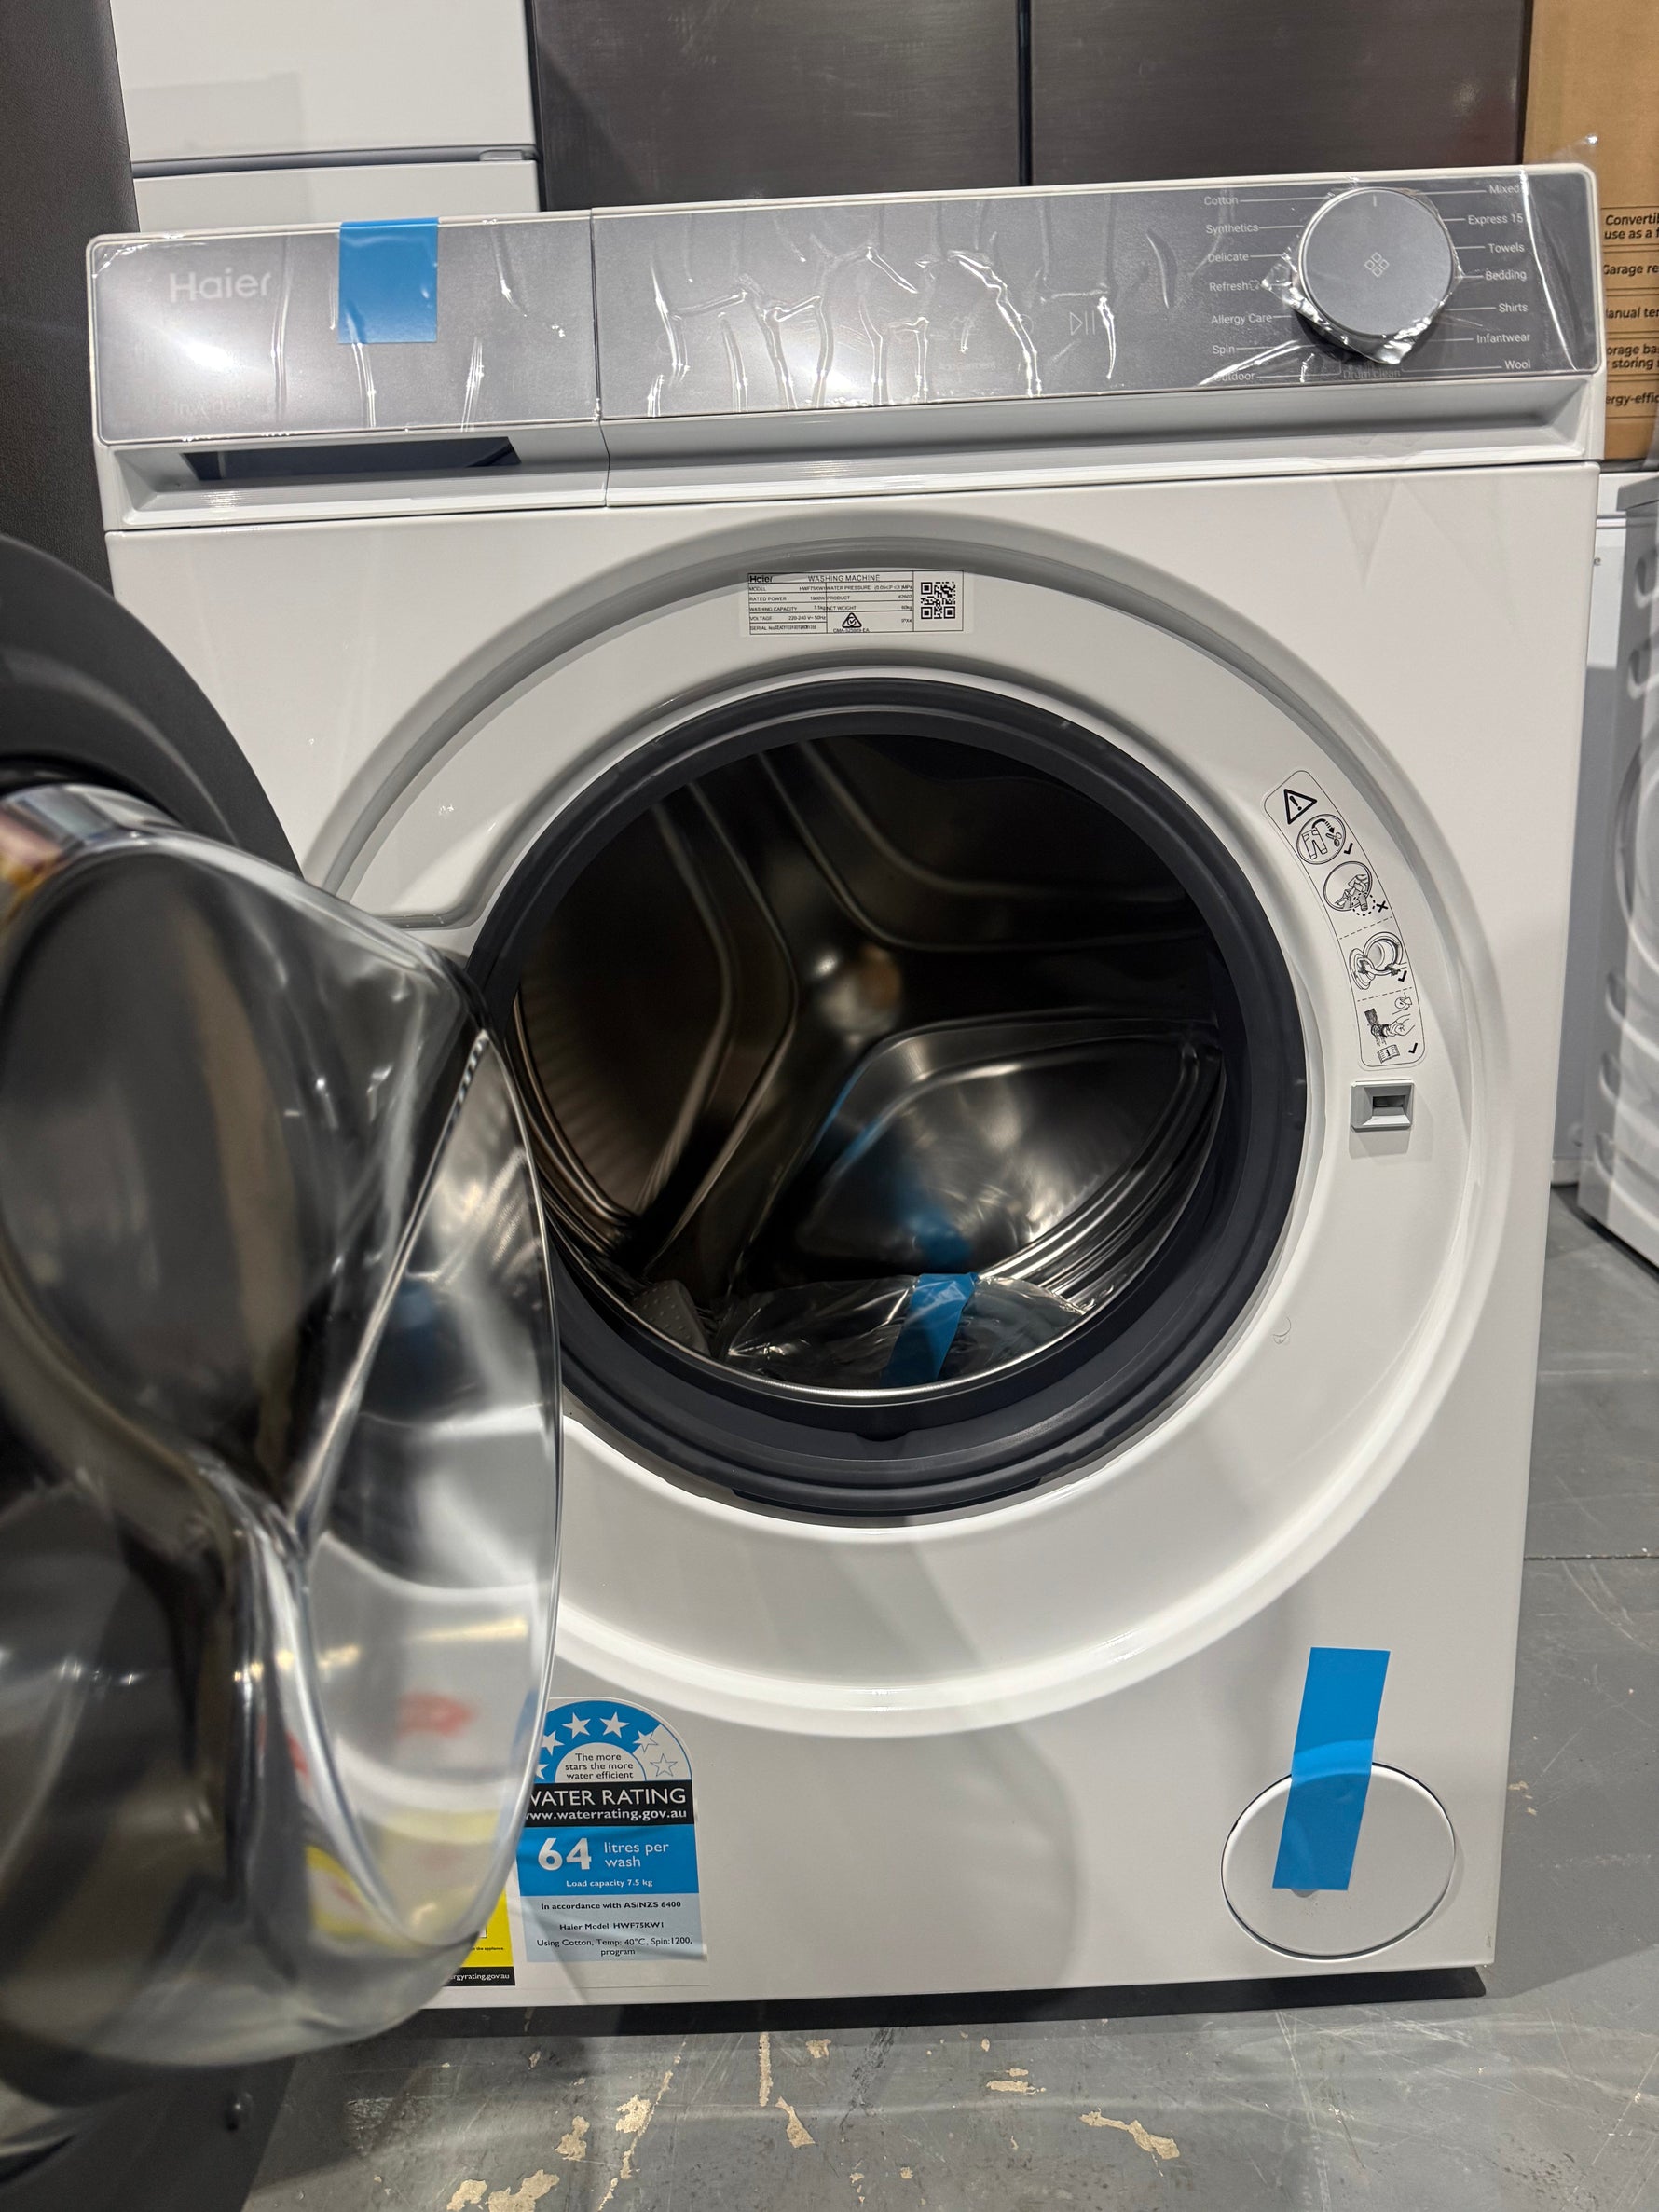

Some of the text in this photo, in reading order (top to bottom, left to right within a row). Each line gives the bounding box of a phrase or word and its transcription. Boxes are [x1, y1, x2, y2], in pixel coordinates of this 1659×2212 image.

[1489, 185, 1521, 194] Mixed
[1203, 196, 1239, 206] Cotton
[1468, 213, 1523, 227] Express 15
[1606, 213, 1659, 226] Converti
[1206, 224, 1259, 236] Synthetics
[1604, 230, 1625, 240] use
[1628, 229, 1642, 239] as
[1645, 229, 1652, 239] a
[1488, 242, 1525, 253] Towels
[1208, 253, 1249, 262] Delicate
[1485, 270, 1527, 282] Bedding
[1603, 264, 1643, 277] Garage
[169, 267, 272, 304] Haier
[1209, 281, 1249, 292] Refresh
[1498, 302, 1529, 313] Shirts
[1606, 306, 1640, 319] anual
[1211, 313, 1273, 325] Allergy Care
[1476, 333, 1530, 344] Infantwear
[1212, 344, 1236, 356] Spin
[1504, 359, 1531, 370] Wool
[1611, 356, 1653, 370] storing
[749, 574, 773, 583] Haier
[808, 574, 843, 583] WASHING
[575, 1753, 594, 1762] The
[590, 1762, 606, 1770] the
[608, 1762, 634, 1770] more
[596, 1771, 634, 1779] efficient
[602, 1788, 686, 1806] RATING
[526, 1808, 687, 1821] ww.waterrating.gov.au
[538, 1837, 669, 1871] 64 litres per
[605, 1856, 641, 1868] wash
[590, 1879, 624, 1888] capacity
[642, 1879, 653, 1888] kg
[537, 1940, 560, 1948] Using
[562, 1938, 594, 1947] Cotton,
[596, 1938, 623, 1946] Temp:
[600, 1948, 636, 1957] program
[451, 1973, 510, 1982] rgyrating.gov.au
